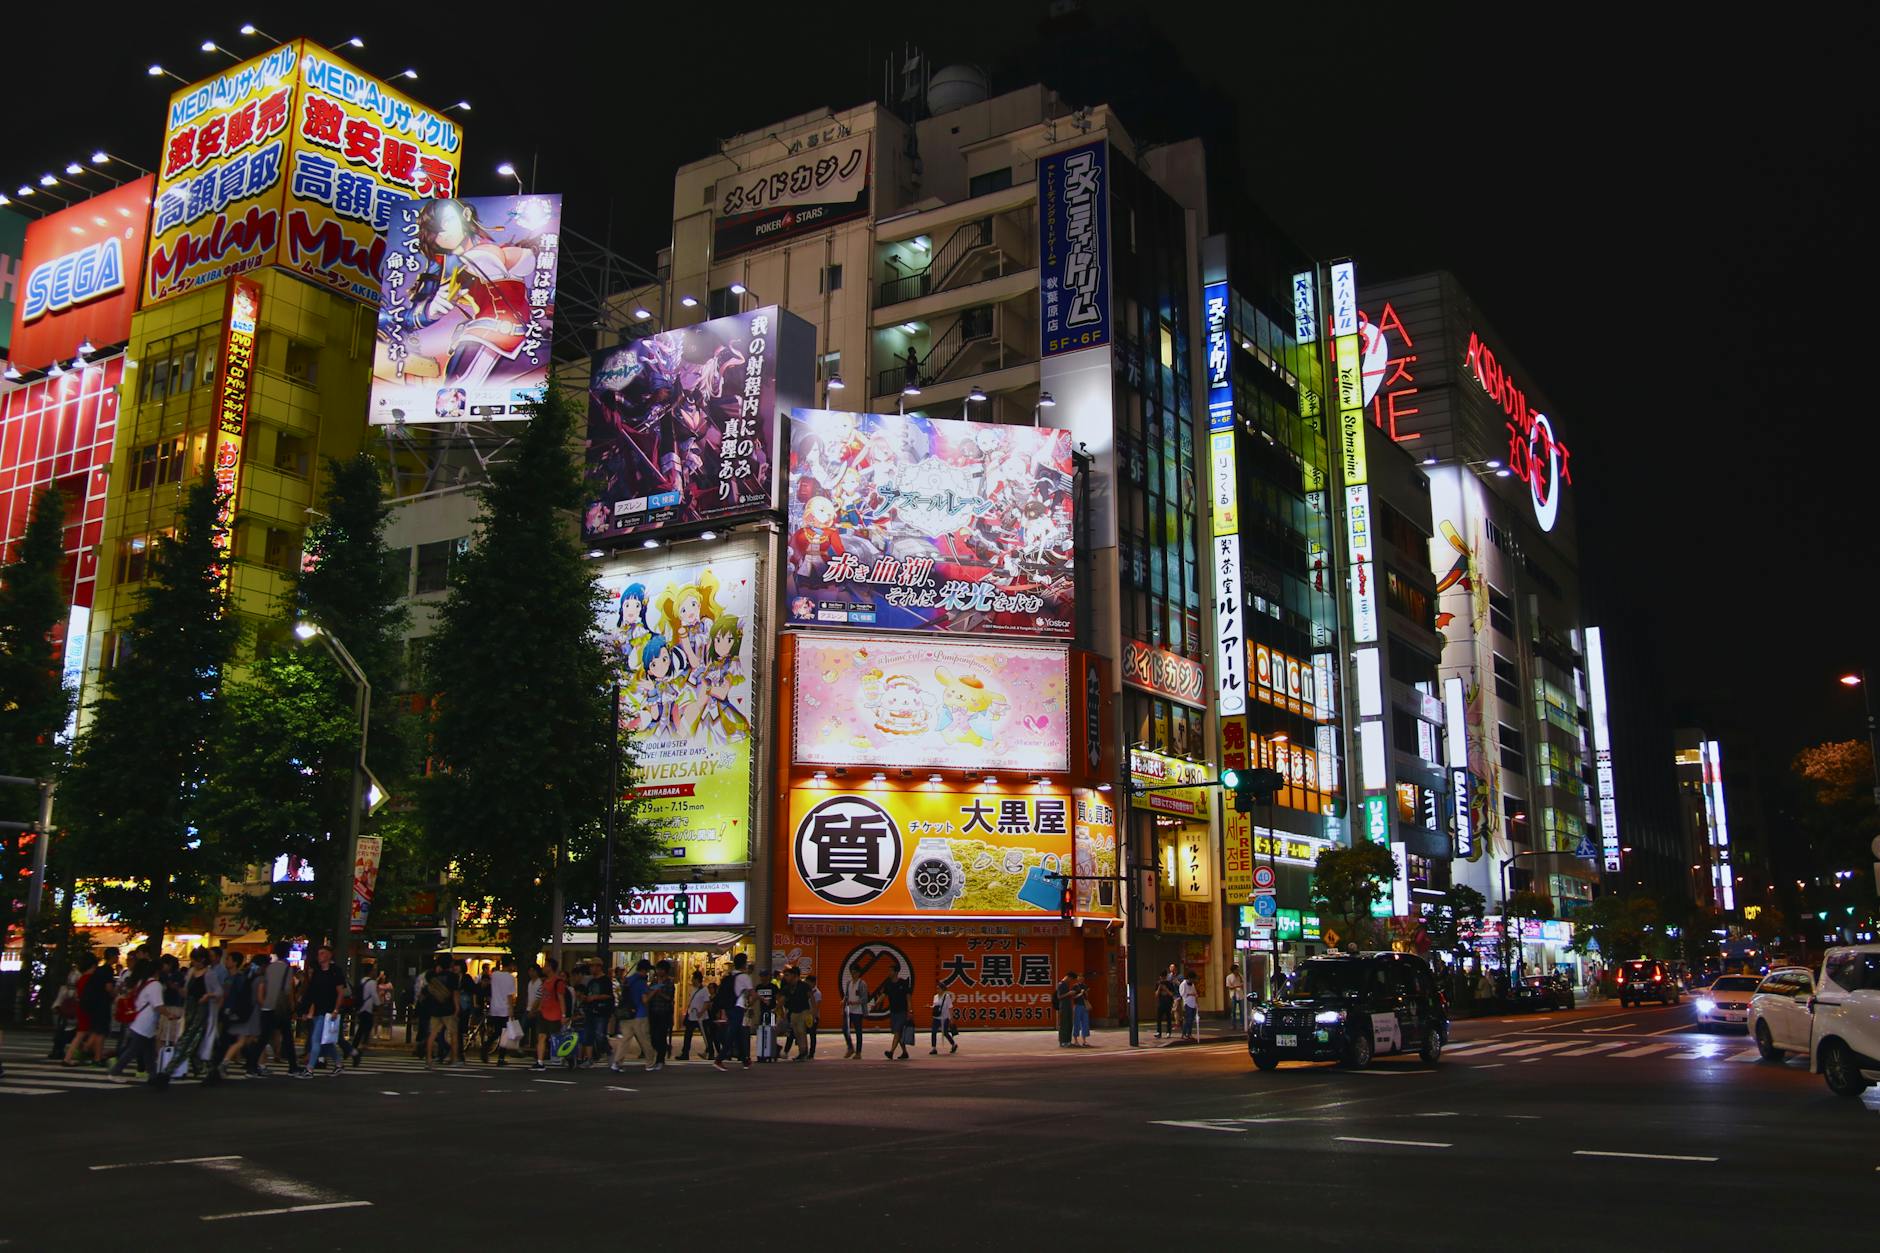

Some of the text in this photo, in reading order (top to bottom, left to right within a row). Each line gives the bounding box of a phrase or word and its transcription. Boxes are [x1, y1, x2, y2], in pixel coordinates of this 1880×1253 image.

[170, 44, 296, 131] MEDIAリサイクル
[306, 55, 457, 152] MEDIAリサイクル
[164, 85, 291, 180] 激安販売
[303, 93, 454, 199] 激安販売
[155, 140, 283, 238] 高額買取
[293, 151, 412, 230] 高額買
[723, 149, 862, 215] メイドカジノ
[287, 209, 386, 283] Mul
[402, 209, 420, 272] いつでも
[755, 207, 823, 236] POKER STARS
[23, 236, 125, 322] SEGA
[151, 206, 278, 298] Mulan
[158, 277, 195, 299] ムーラン
[194, 269, 222, 288] AKIBA
[231, 333, 251, 347] DVD
[230, 366, 245, 379] CD
[734, 316, 769, 479] 我の射程内にのみ
[1341, 368, 1352, 406] Yellow
[719, 418, 739, 501] 真理あり
[1344, 415, 1357, 479] Submarine
[1122, 643, 1205, 700] メイドカジノ
[909, 821, 953, 833] チケット
[961, 798, 1066, 835] 大黒屋
[1453, 771, 1470, 855] GALLERIA
[809, 812, 888, 891] 質
[1189, 844, 1200, 892] ルノアール
[1239, 827, 1250, 870] FREE
[1258, 872, 1270, 882] 40
[219, 917, 250, 932] ラーメ
[620, 913, 666, 924] kihabara
[967, 937, 1028, 950] チケット
[940, 954, 1054, 989] 大黒屋
[952, 1007, 1051, 1022] 3(3254)5351
